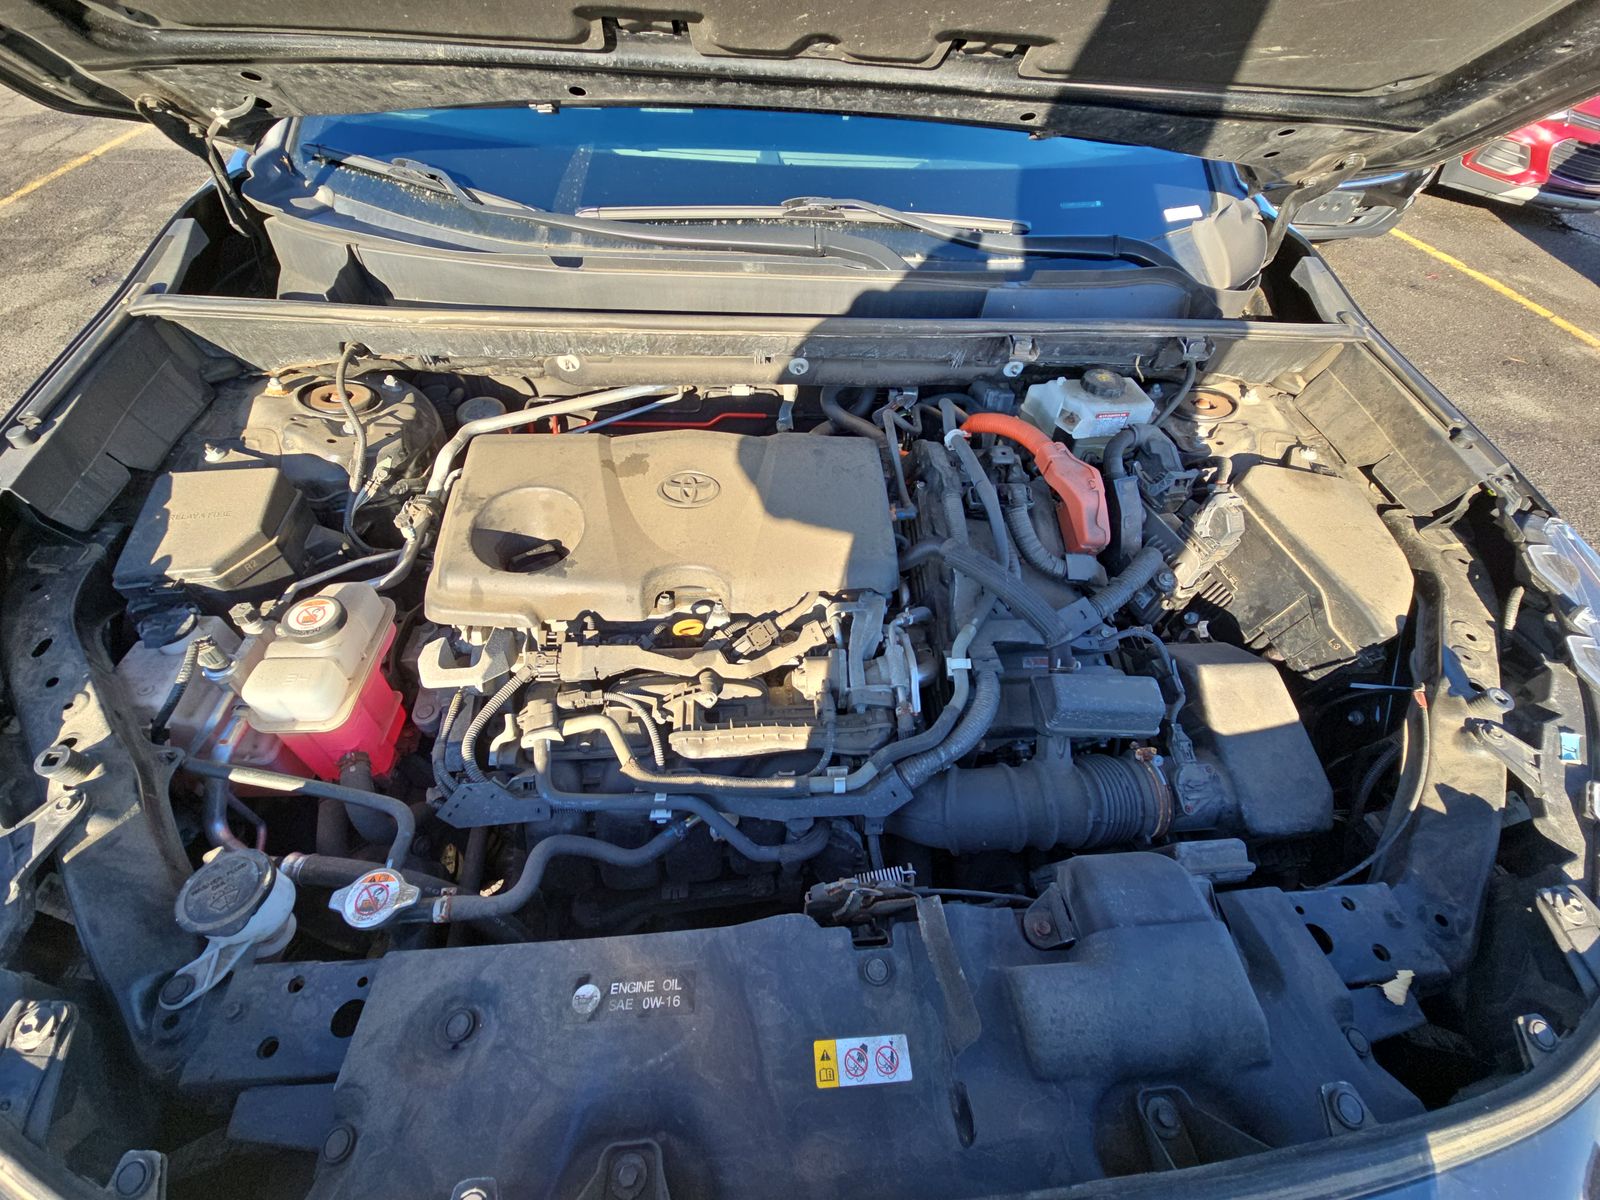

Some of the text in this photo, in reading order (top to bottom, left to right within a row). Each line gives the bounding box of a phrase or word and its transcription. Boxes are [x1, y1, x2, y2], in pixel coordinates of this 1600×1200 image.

[244, 560, 258, 573] R2
[610, 979, 682, 995] ENGINE OIL
[609, 995, 681, 1011] SAE 0W-16
